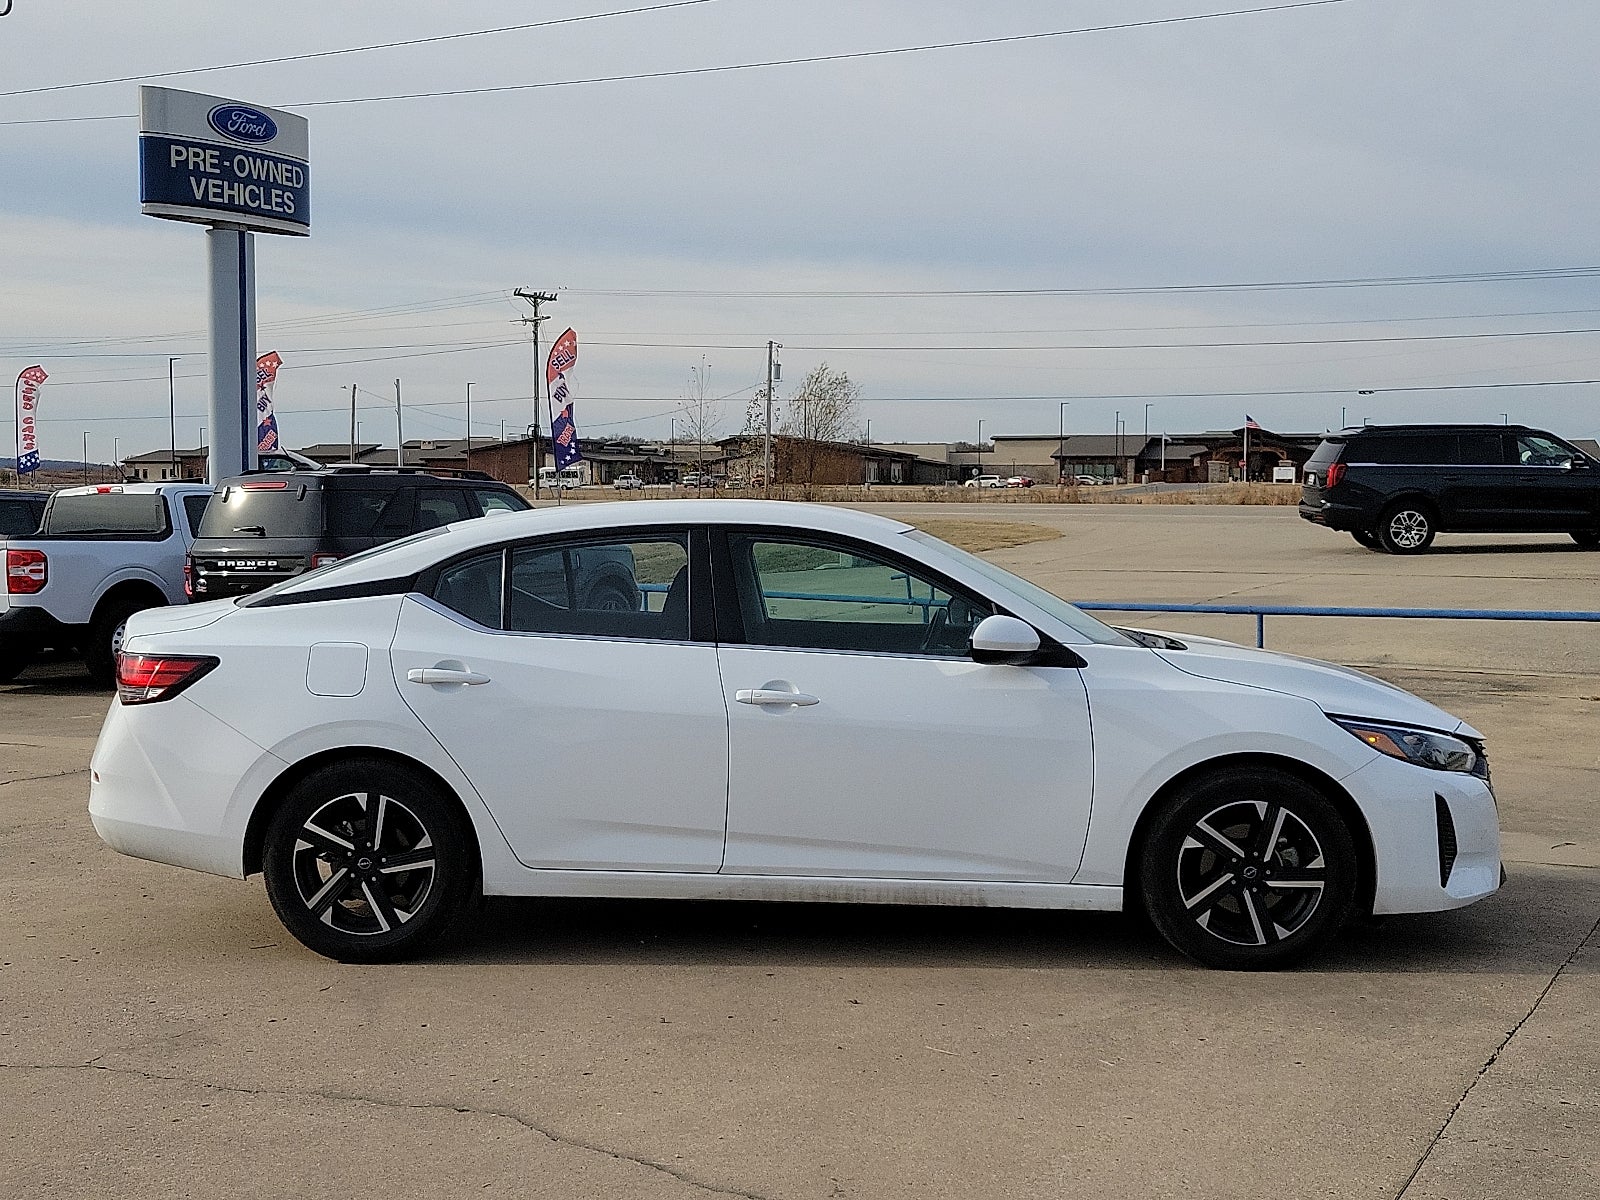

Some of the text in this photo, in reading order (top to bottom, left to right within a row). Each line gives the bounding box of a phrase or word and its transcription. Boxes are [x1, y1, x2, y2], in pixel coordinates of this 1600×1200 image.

[227, 110, 267, 137] Ford
[170, 144, 304, 189] PRE-OWNED
[189, 176, 295, 214] VEHICLES
[551, 349, 575, 370] SELL
[257, 393, 272, 413] BUY
[553, 383, 570, 404] BUY
